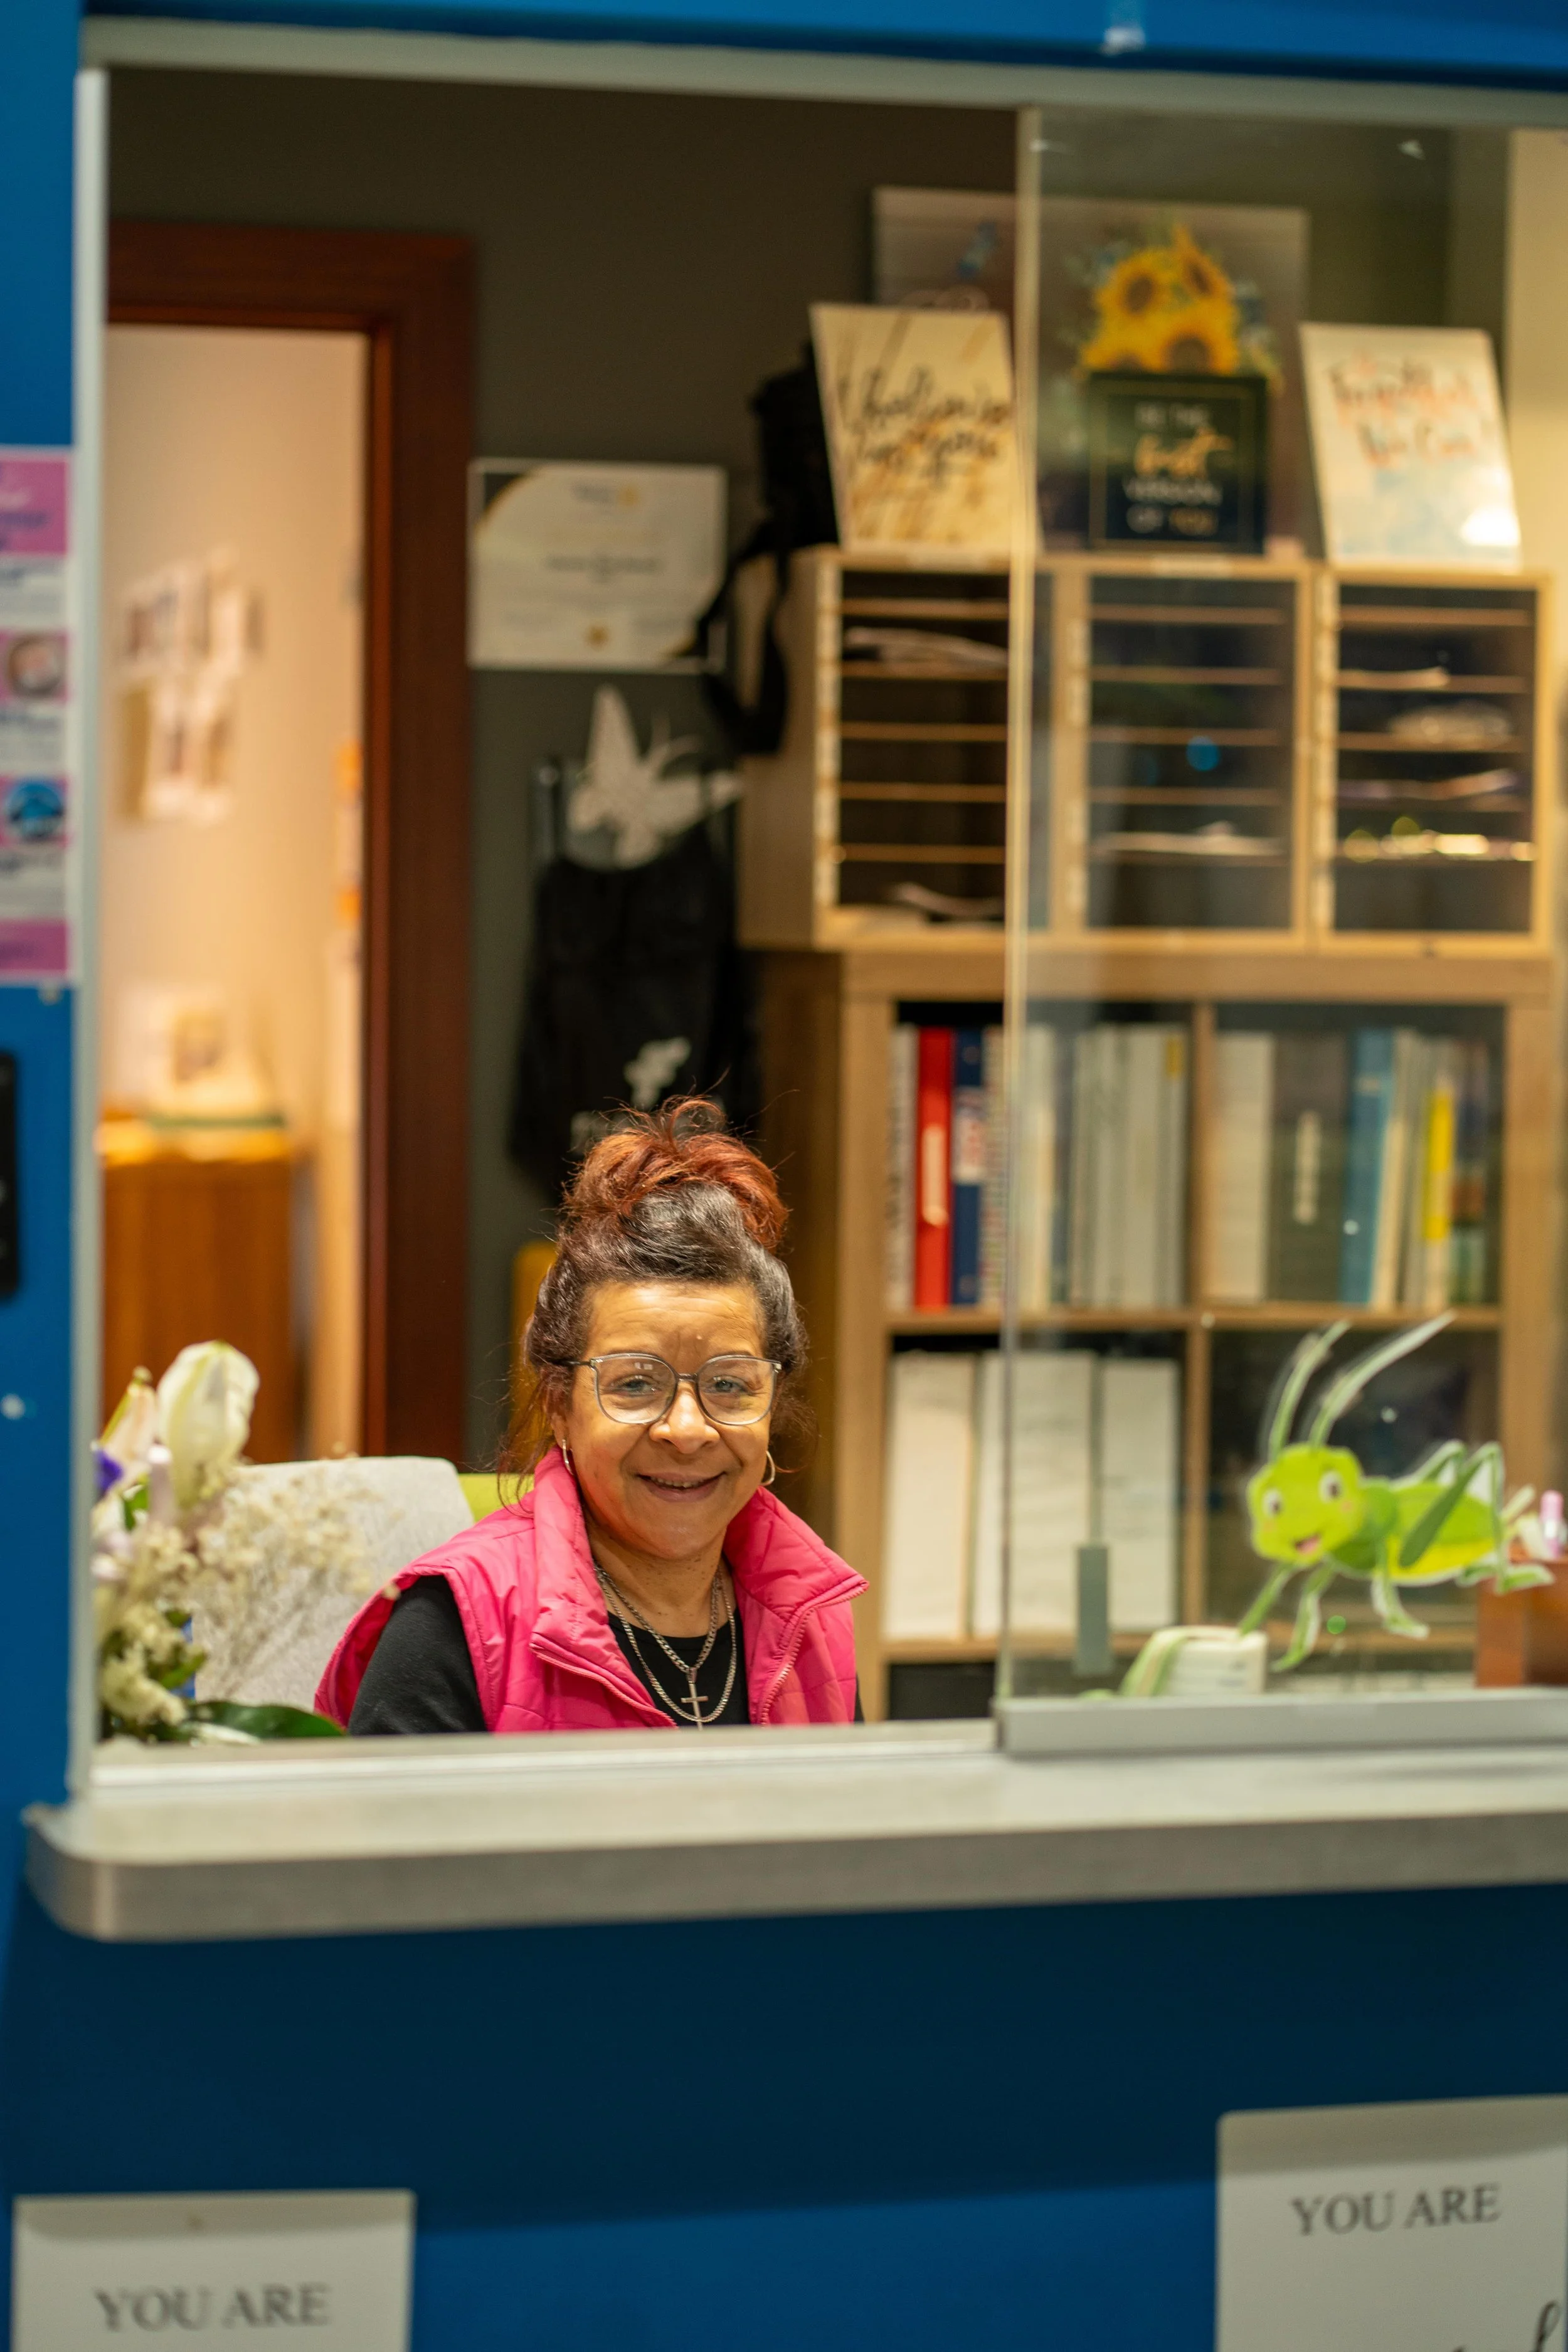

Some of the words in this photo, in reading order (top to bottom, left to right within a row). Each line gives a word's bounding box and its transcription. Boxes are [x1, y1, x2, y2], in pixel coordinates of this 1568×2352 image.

[1125, 476, 1222, 506] VERSION
[1127, 504, 1163, 533] OF
[1168, 507, 1217, 536] YOU
[1290, 2189, 1396, 2237] YOU
[1402, 2181, 1503, 2229] ARE
[93, 2286, 214, 2333] YOU
[221, 2282, 332, 2329] ARE
